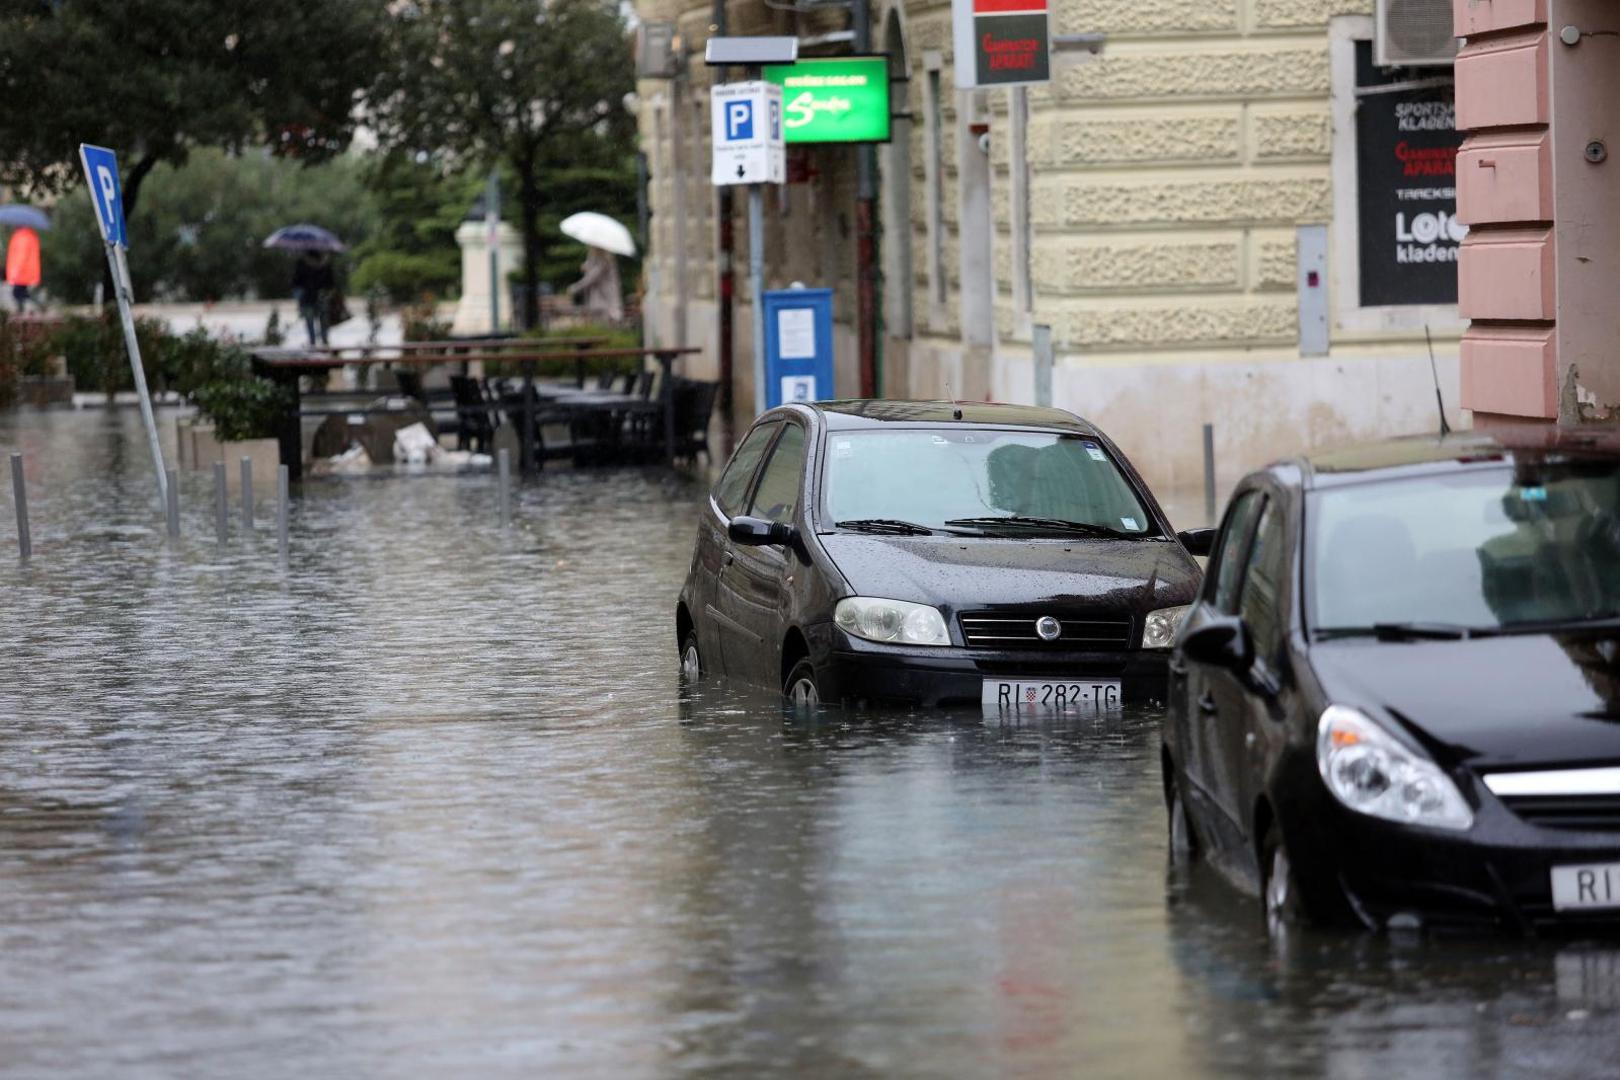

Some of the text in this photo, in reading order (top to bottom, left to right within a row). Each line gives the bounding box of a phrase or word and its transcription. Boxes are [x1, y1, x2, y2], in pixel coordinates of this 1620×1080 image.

[730, 103, 750, 137] P
[97, 165, 116, 224] P
[999, 683, 1020, 704] RI
[1577, 869, 1611, 902] RI
